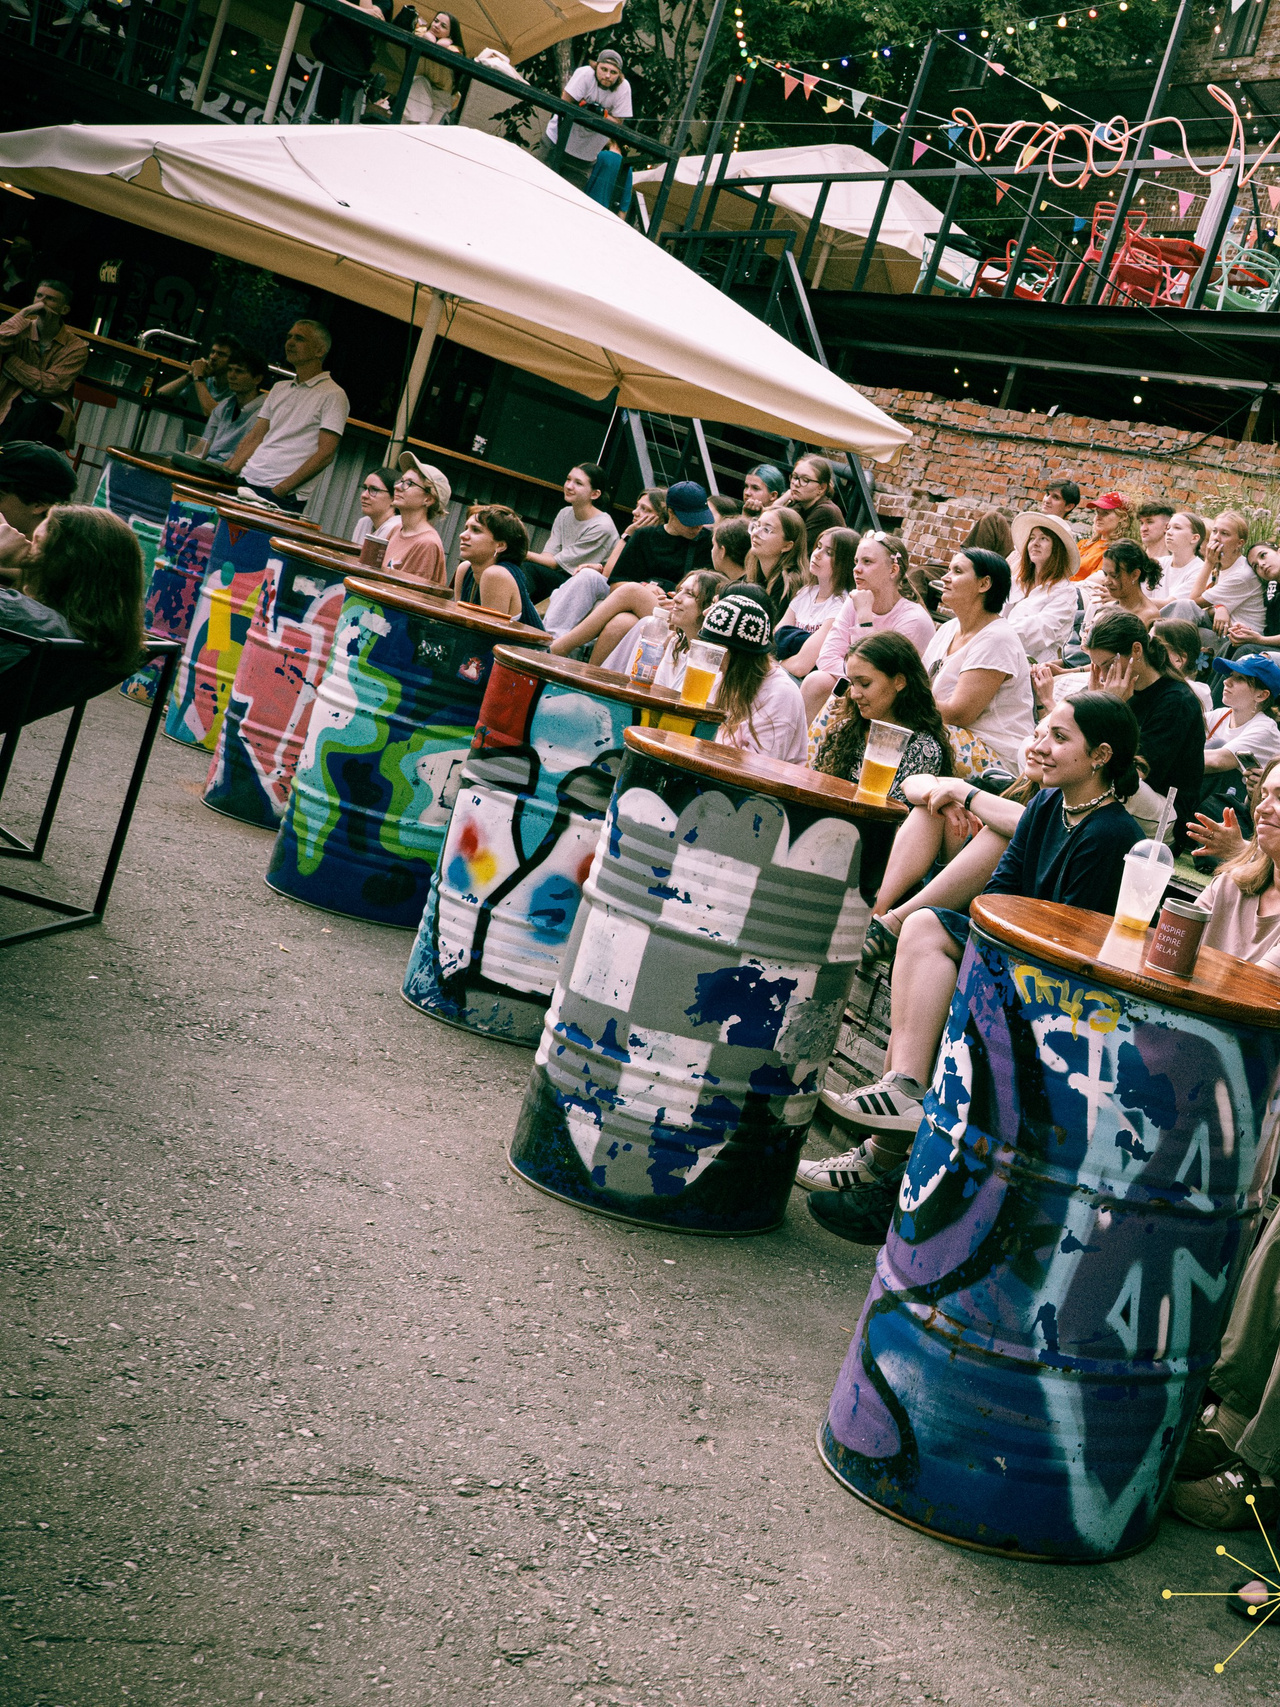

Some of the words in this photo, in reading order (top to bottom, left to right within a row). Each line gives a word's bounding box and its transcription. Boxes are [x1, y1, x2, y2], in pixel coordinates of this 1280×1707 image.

[1161, 923, 1186, 938] INSPIRE
[1158, 932, 1181, 947] EXPIRE
[1155, 943, 1178, 957] RELAX
